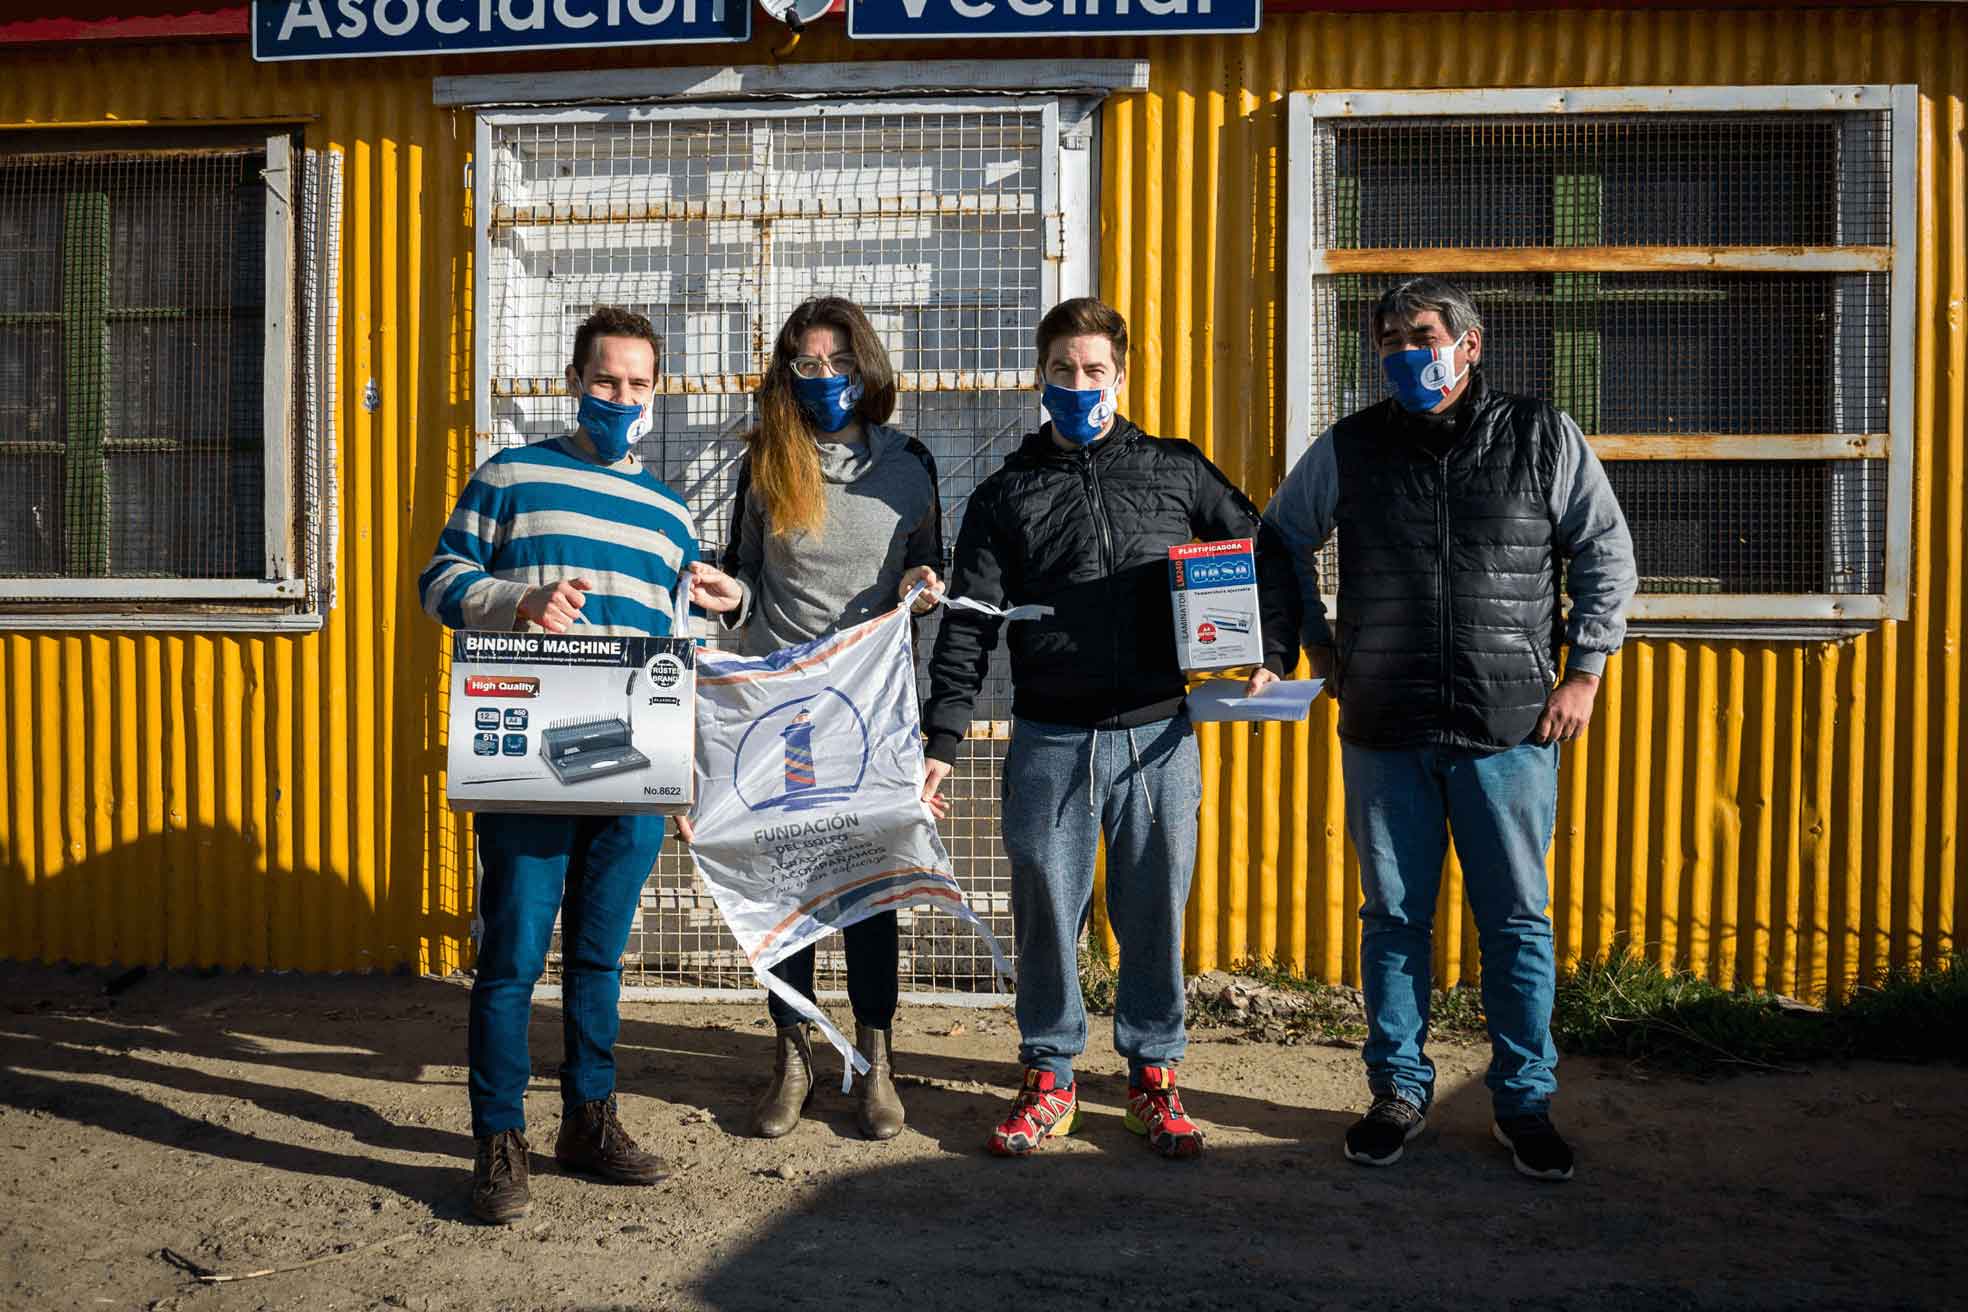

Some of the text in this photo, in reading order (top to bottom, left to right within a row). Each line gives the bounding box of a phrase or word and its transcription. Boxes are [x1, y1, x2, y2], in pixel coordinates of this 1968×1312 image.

[1178, 543, 1242, 554] PLASTIFICADORA
[466, 637, 621, 655] BINDING MACHINE
[471, 681, 535, 694] High Quality
[644, 786, 681, 797] No.8622
[754, 813, 860, 845] FUNDACIÓN
